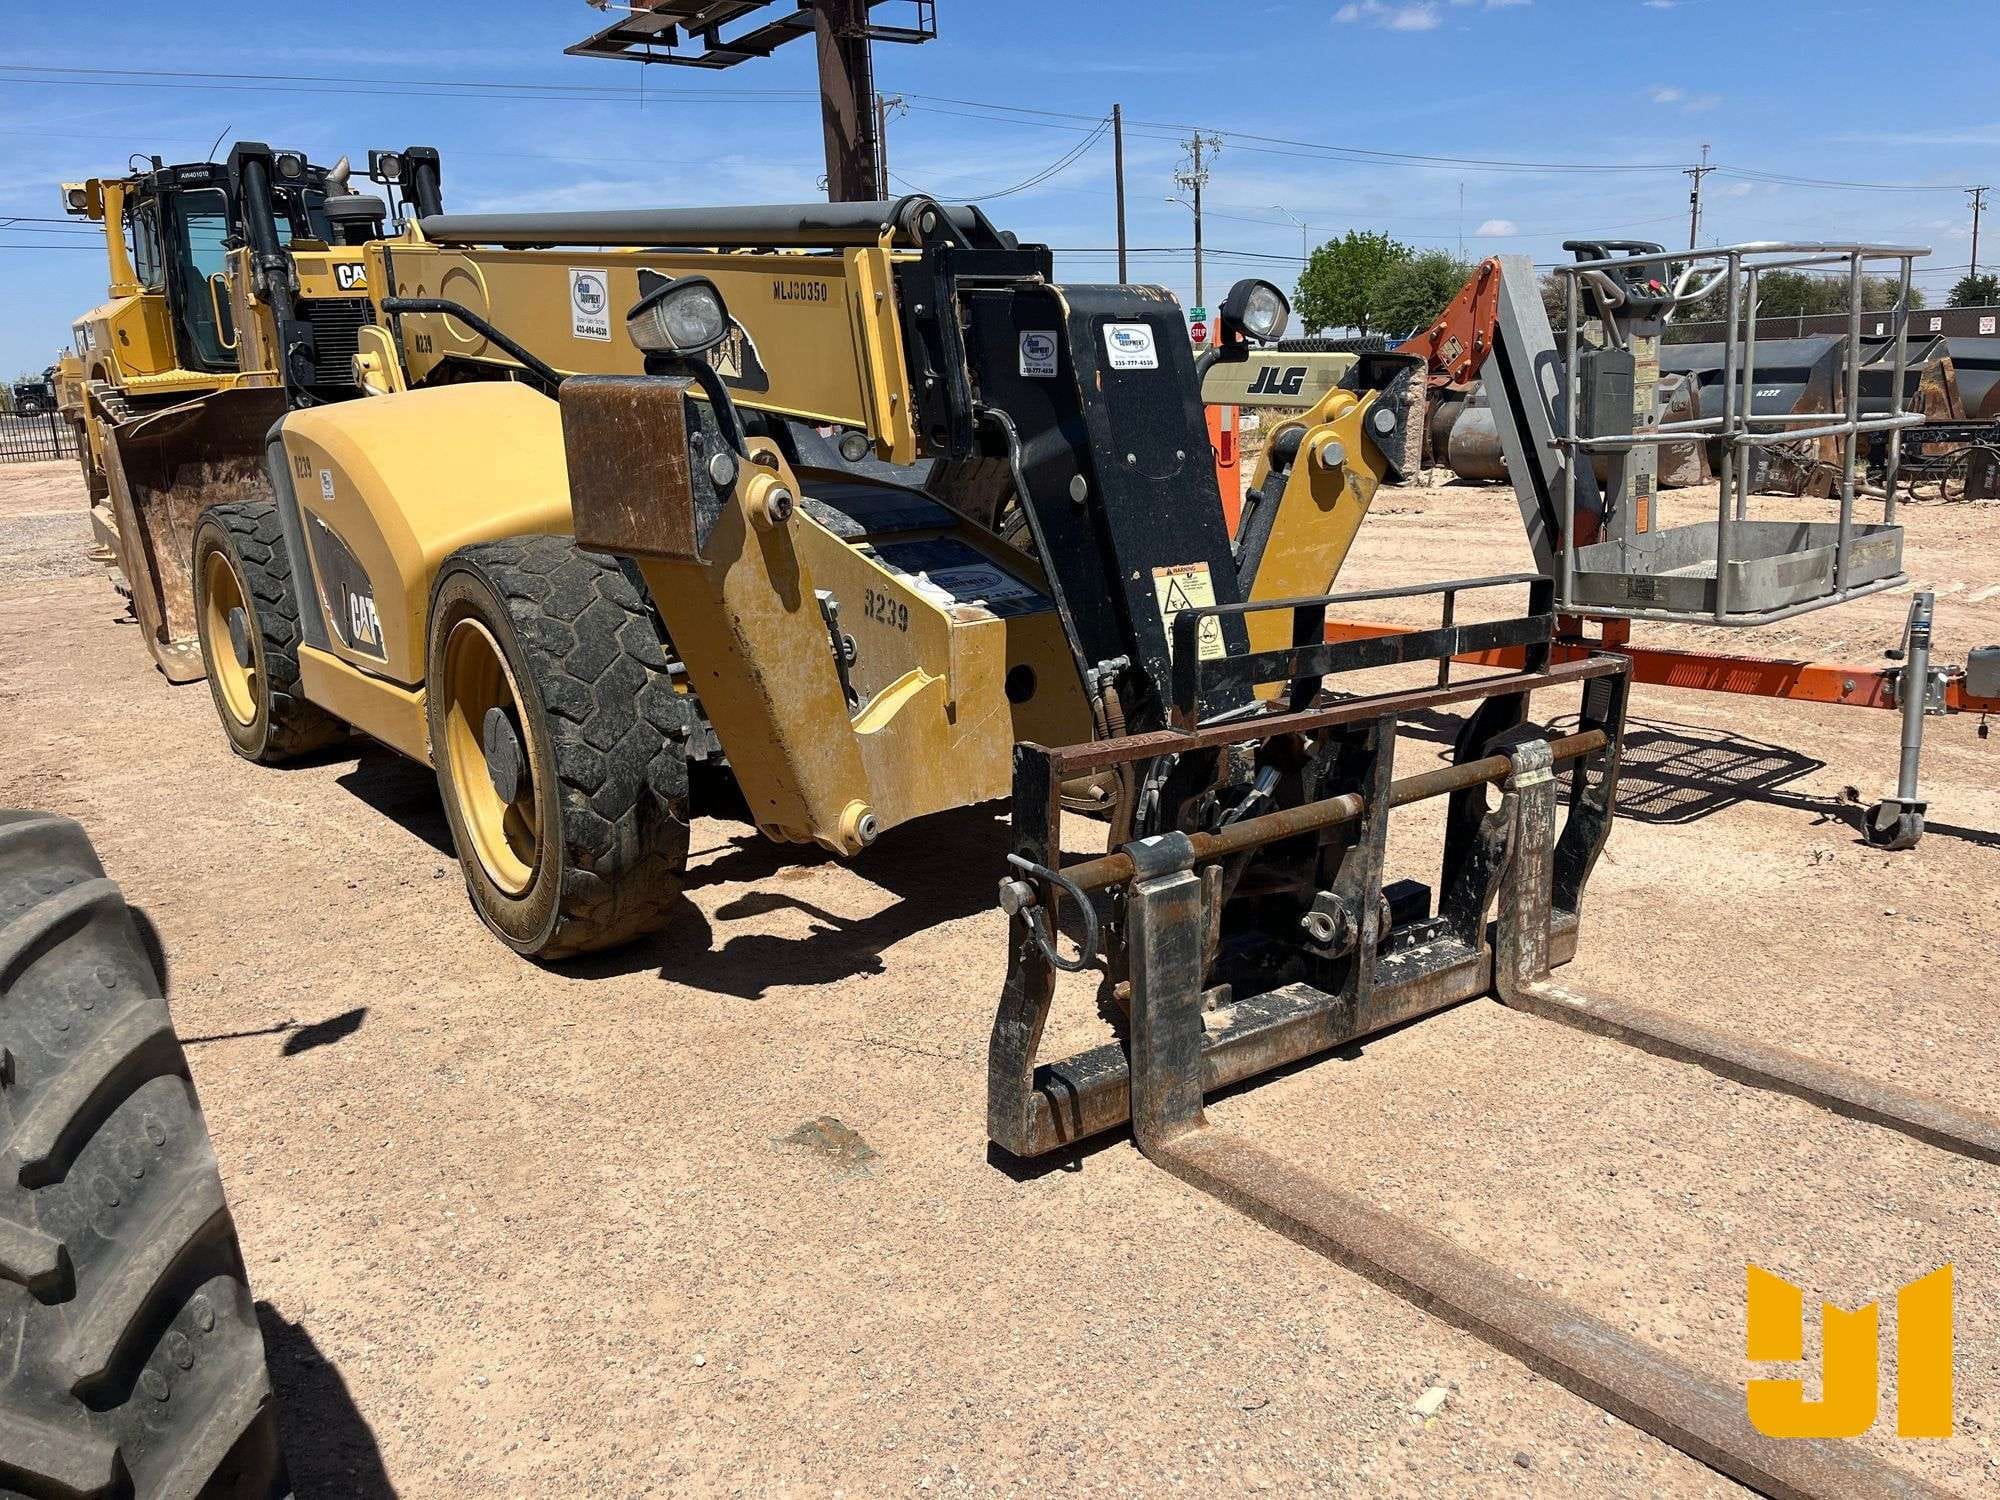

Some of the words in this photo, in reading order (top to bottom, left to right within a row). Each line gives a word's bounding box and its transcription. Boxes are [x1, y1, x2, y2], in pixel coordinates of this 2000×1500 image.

[338, 264, 368, 289] CA
[1246, 365, 1309, 396] JLG
[1172, 565, 1196, 574] WARNING
[350, 591, 378, 646] CAT
